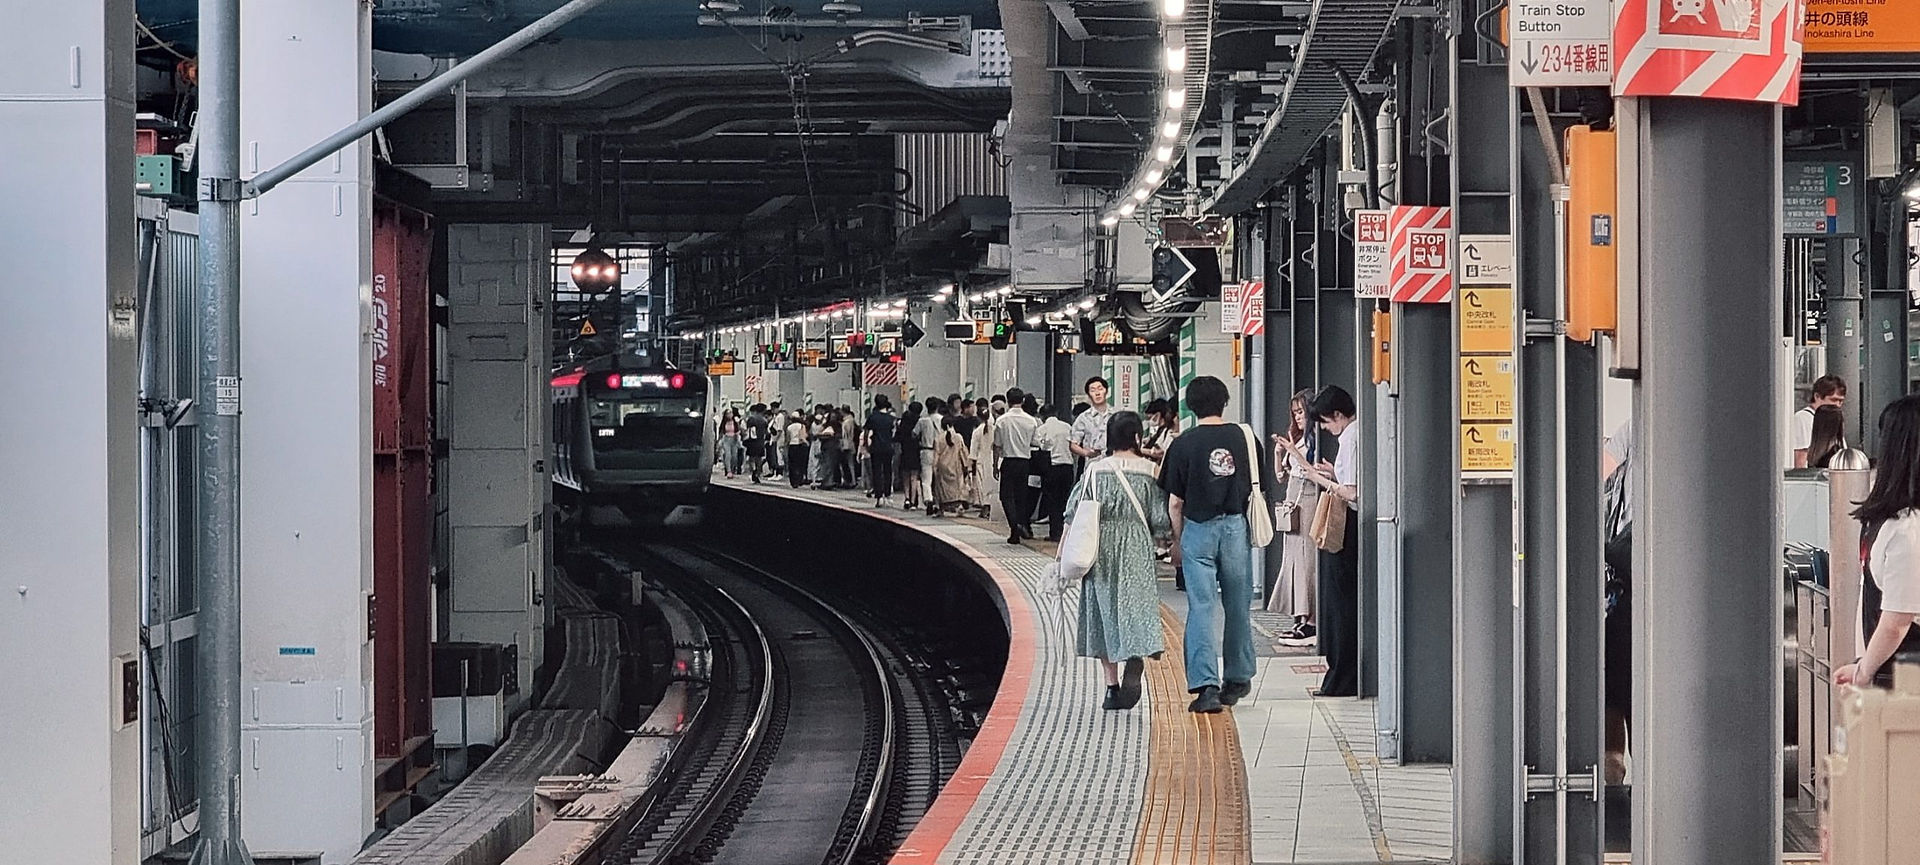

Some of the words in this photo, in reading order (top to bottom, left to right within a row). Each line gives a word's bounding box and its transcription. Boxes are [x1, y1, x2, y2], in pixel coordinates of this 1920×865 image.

[1519, 4, 1551, 16] Train
[1556, 4, 1585, 17] Stop
[1805, 11, 1869, 27] 井の頭線
[1519, 20, 1561, 32] Button
[1804, 29, 1852, 38] Inokashira
[1854, 29, 1874, 38] Line
[1838, 165, 1852, 186] 3
[1360, 214, 1386, 224] STOP
[1412, 234, 1444, 245] STOP
[1358, 245, 1387, 254] 非常停止
[1466, 310, 1497, 319] 中央改札
[996, 324, 1005, 336] 2
[866, 334, 874, 345] 2
[374, 364, 387, 388] 300
